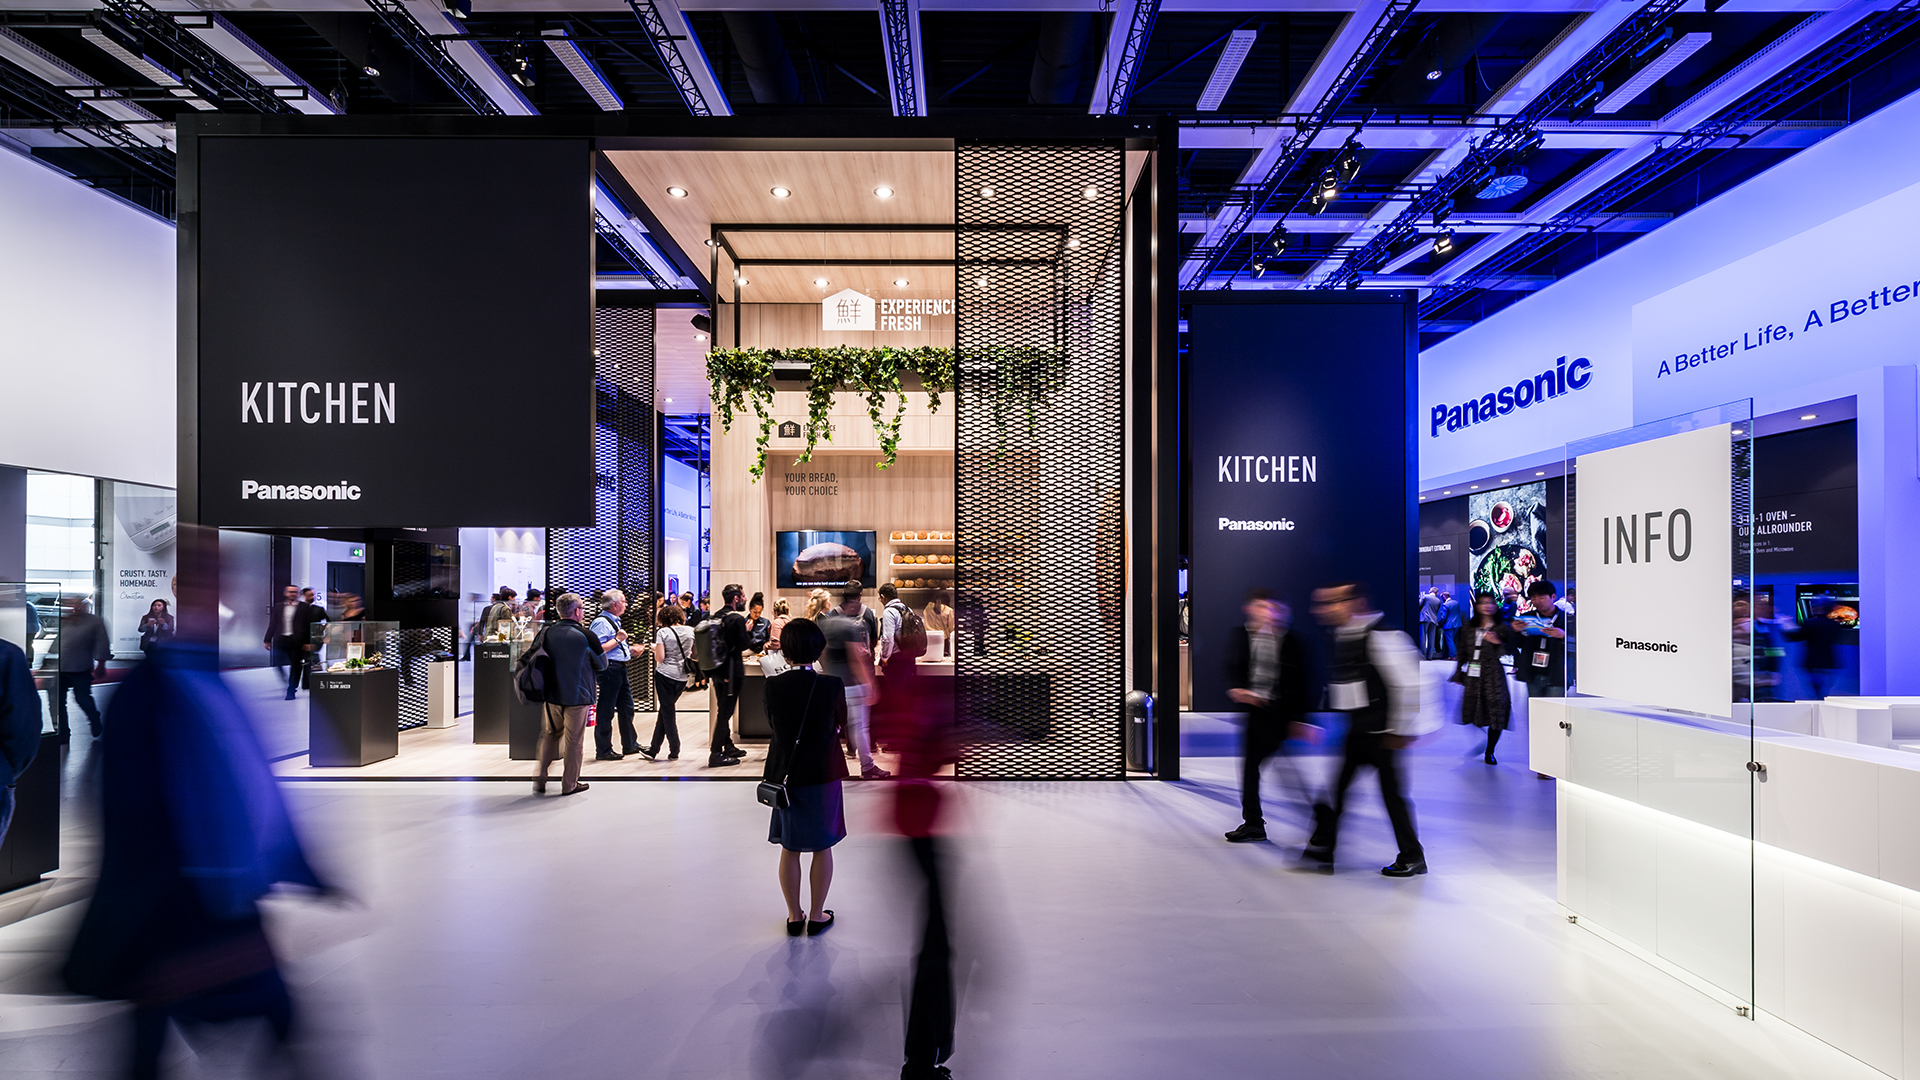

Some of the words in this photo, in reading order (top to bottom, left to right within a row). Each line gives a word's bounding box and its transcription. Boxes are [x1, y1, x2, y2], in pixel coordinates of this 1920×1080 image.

[836, 299, 861, 324] 鮮
[881, 299, 955, 315] EXPERIENCE
[881, 316, 921, 331] FRESH
[1657, 360, 1672, 379] A
[1675, 339, 1739, 373] Better
[1743, 324, 1795, 351] Life,
[1803, 309, 1824, 333] A
[1830, 279, 1920, 324] Better
[241, 381, 396, 424] KITCHEN
[1431, 355, 1593, 438] Panasonic
[1218, 455, 1317, 483] KITCHEN
[785, 473, 806, 482] YOUR
[809, 473, 838, 483] BREAD,
[241, 479, 362, 501] Panasonic
[785, 486, 806, 496] YOUR
[809, 486, 838, 496] CHOICE
[1218, 517, 1295, 531] Panasonic
[1766, 511, 1788, 521] OVEN
[1757, 521, 1812, 534] ALLROUNDER
[1603, 508, 1692, 565] INFO
[1615, 637, 1678, 654] Panasonic
